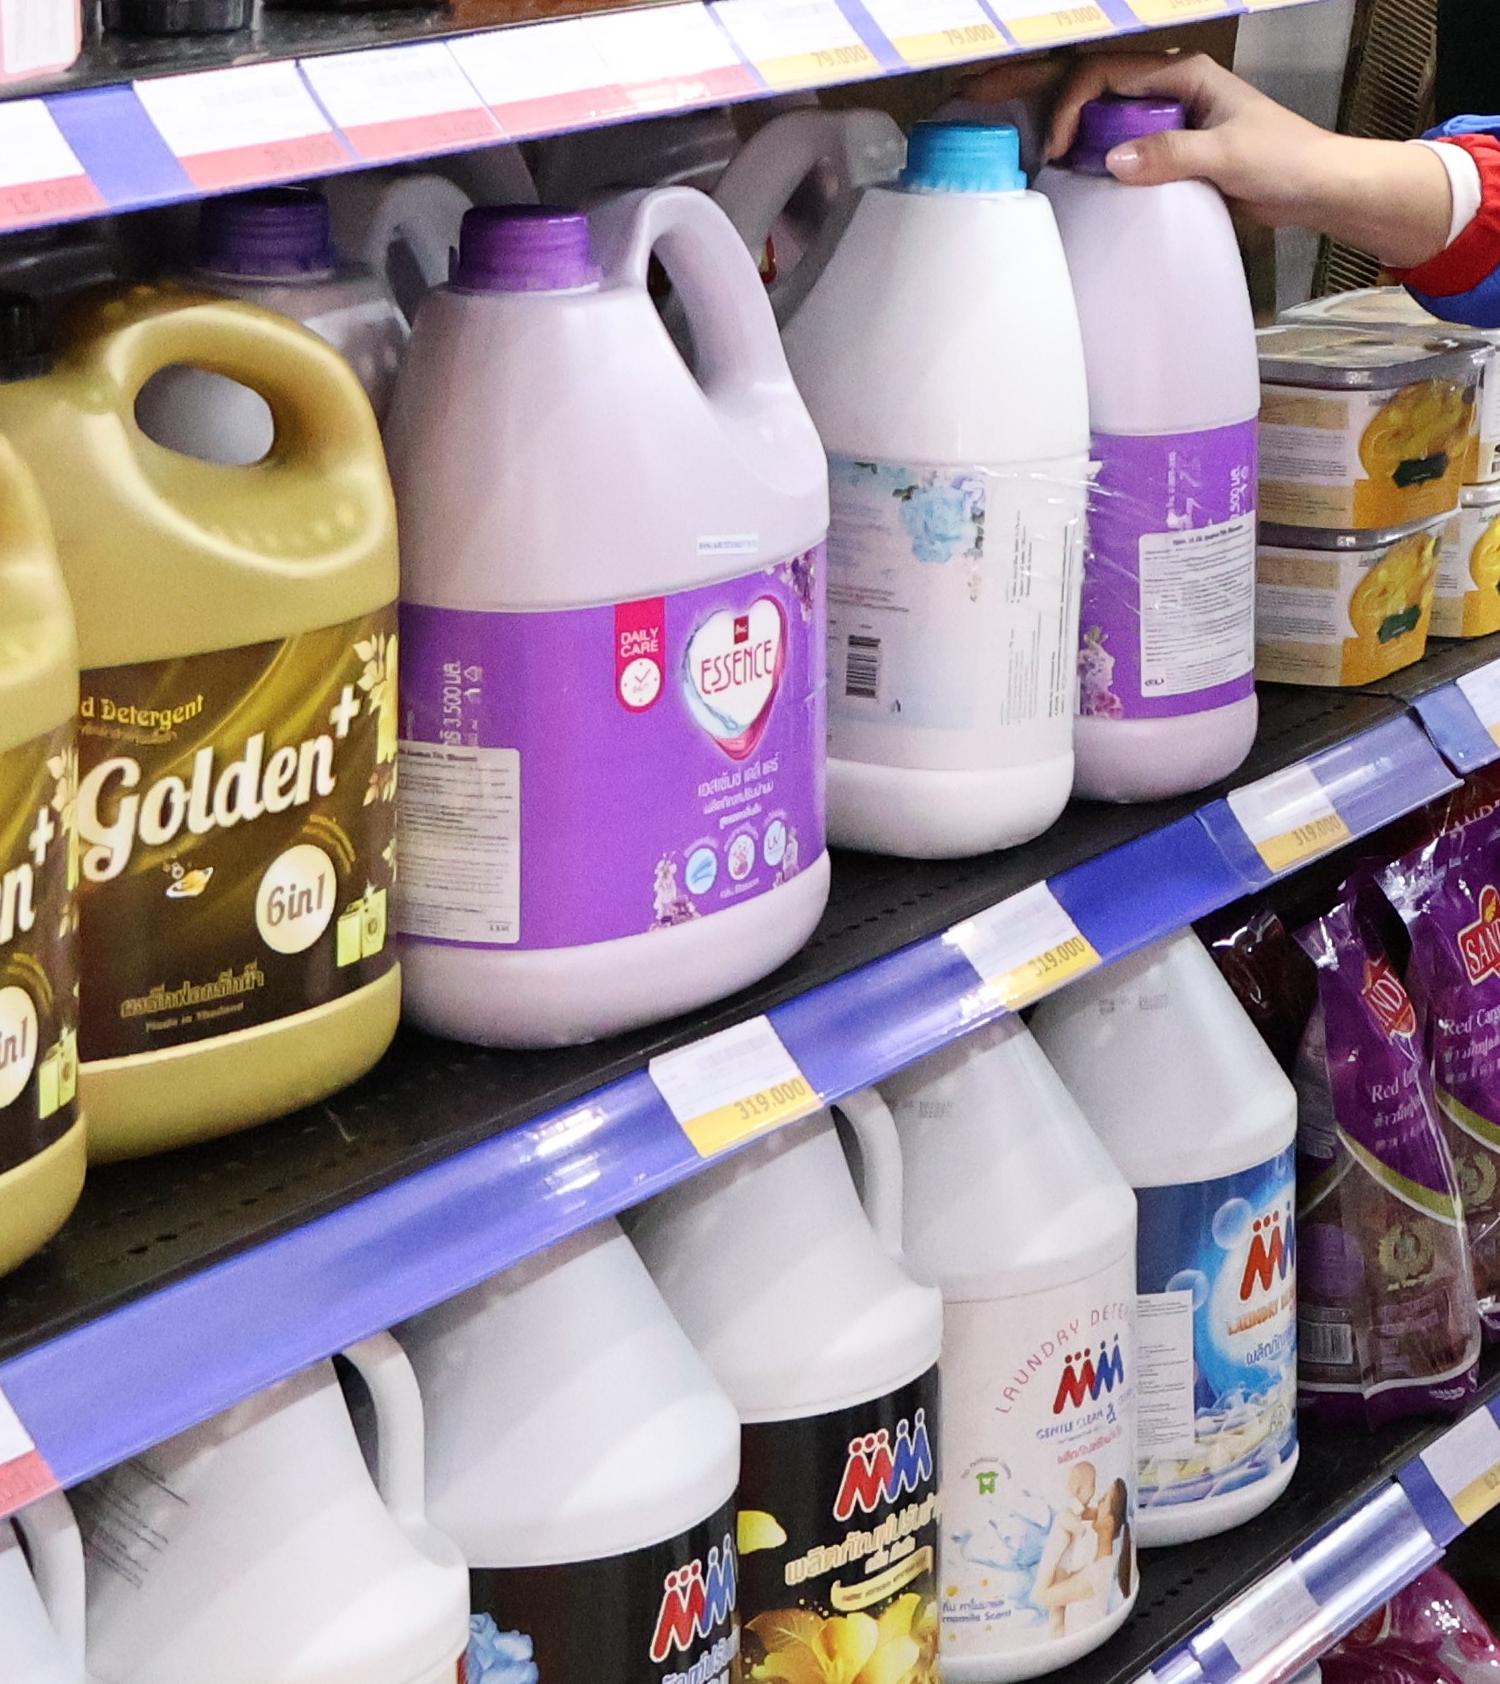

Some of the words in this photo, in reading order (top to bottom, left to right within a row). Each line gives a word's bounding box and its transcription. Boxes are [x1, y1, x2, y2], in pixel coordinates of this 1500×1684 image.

[941, 22, 996, 46] 79.000
[810, 44, 868, 69] 79.000
[620, 627, 660, 646] DAILY
[620, 641, 660, 658] CARE
[699, 639, 775, 696] ESSENCE
[100, 693, 205, 732] Detergent
[1291, 812, 1342, 847] 319.000
[266, 874, 326, 928] 6in1
[1027, 935, 1086, 978] 319.000
[1443, 1016, 1475, 1038] Red
[734, 1077, 808, 1122] 319.000
[1370, 1083, 1400, 1105] Red
[995, 1318, 1080, 1414] LAUNDRY
